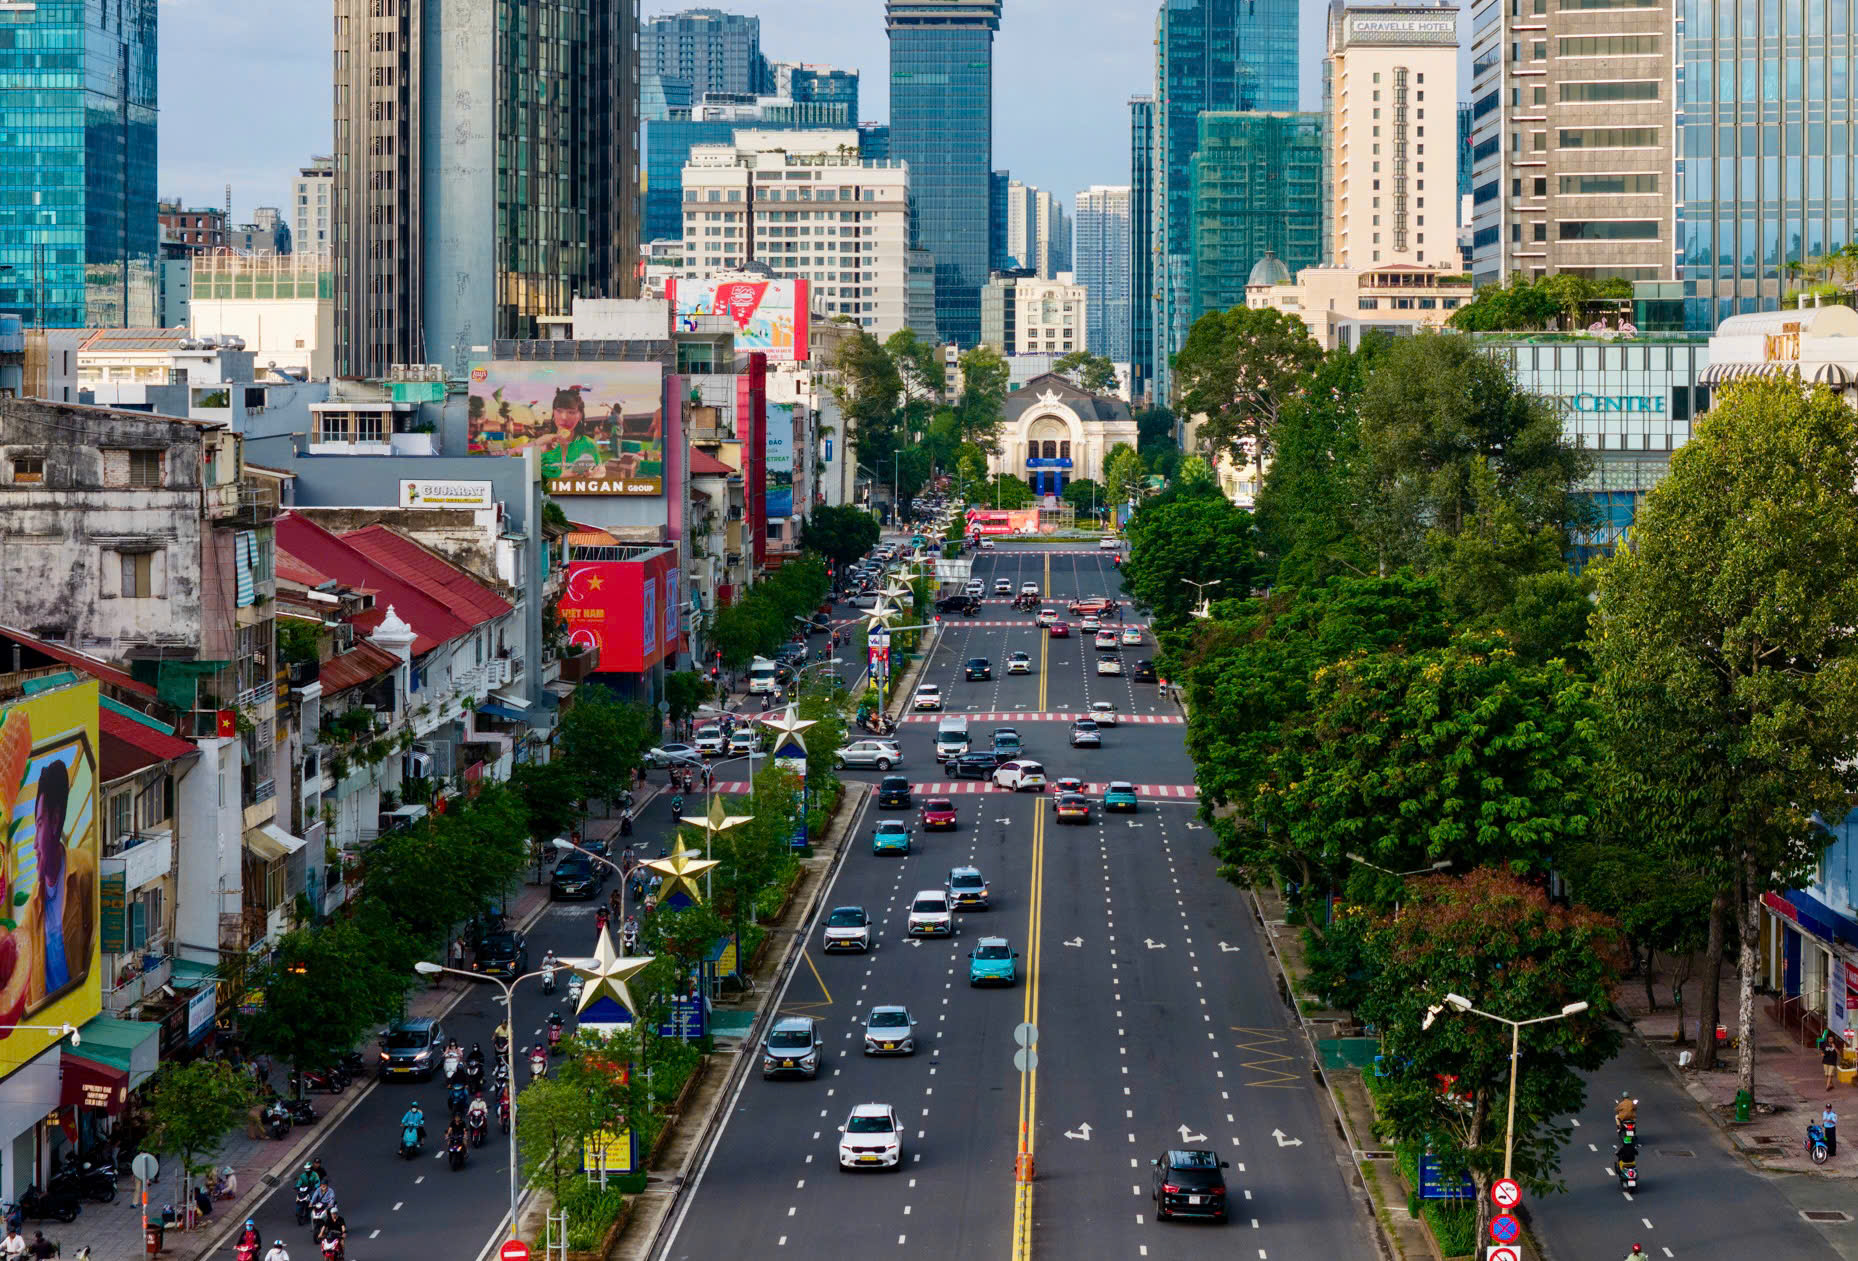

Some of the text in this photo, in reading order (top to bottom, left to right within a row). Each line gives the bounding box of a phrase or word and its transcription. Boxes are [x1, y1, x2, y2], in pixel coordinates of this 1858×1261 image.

[1419, 22, 1451, 30] HOTEL
[423, 486, 485, 497] GUJARAT
[548, 481, 571, 492] IM
[575, 481, 624, 492] NGAN
